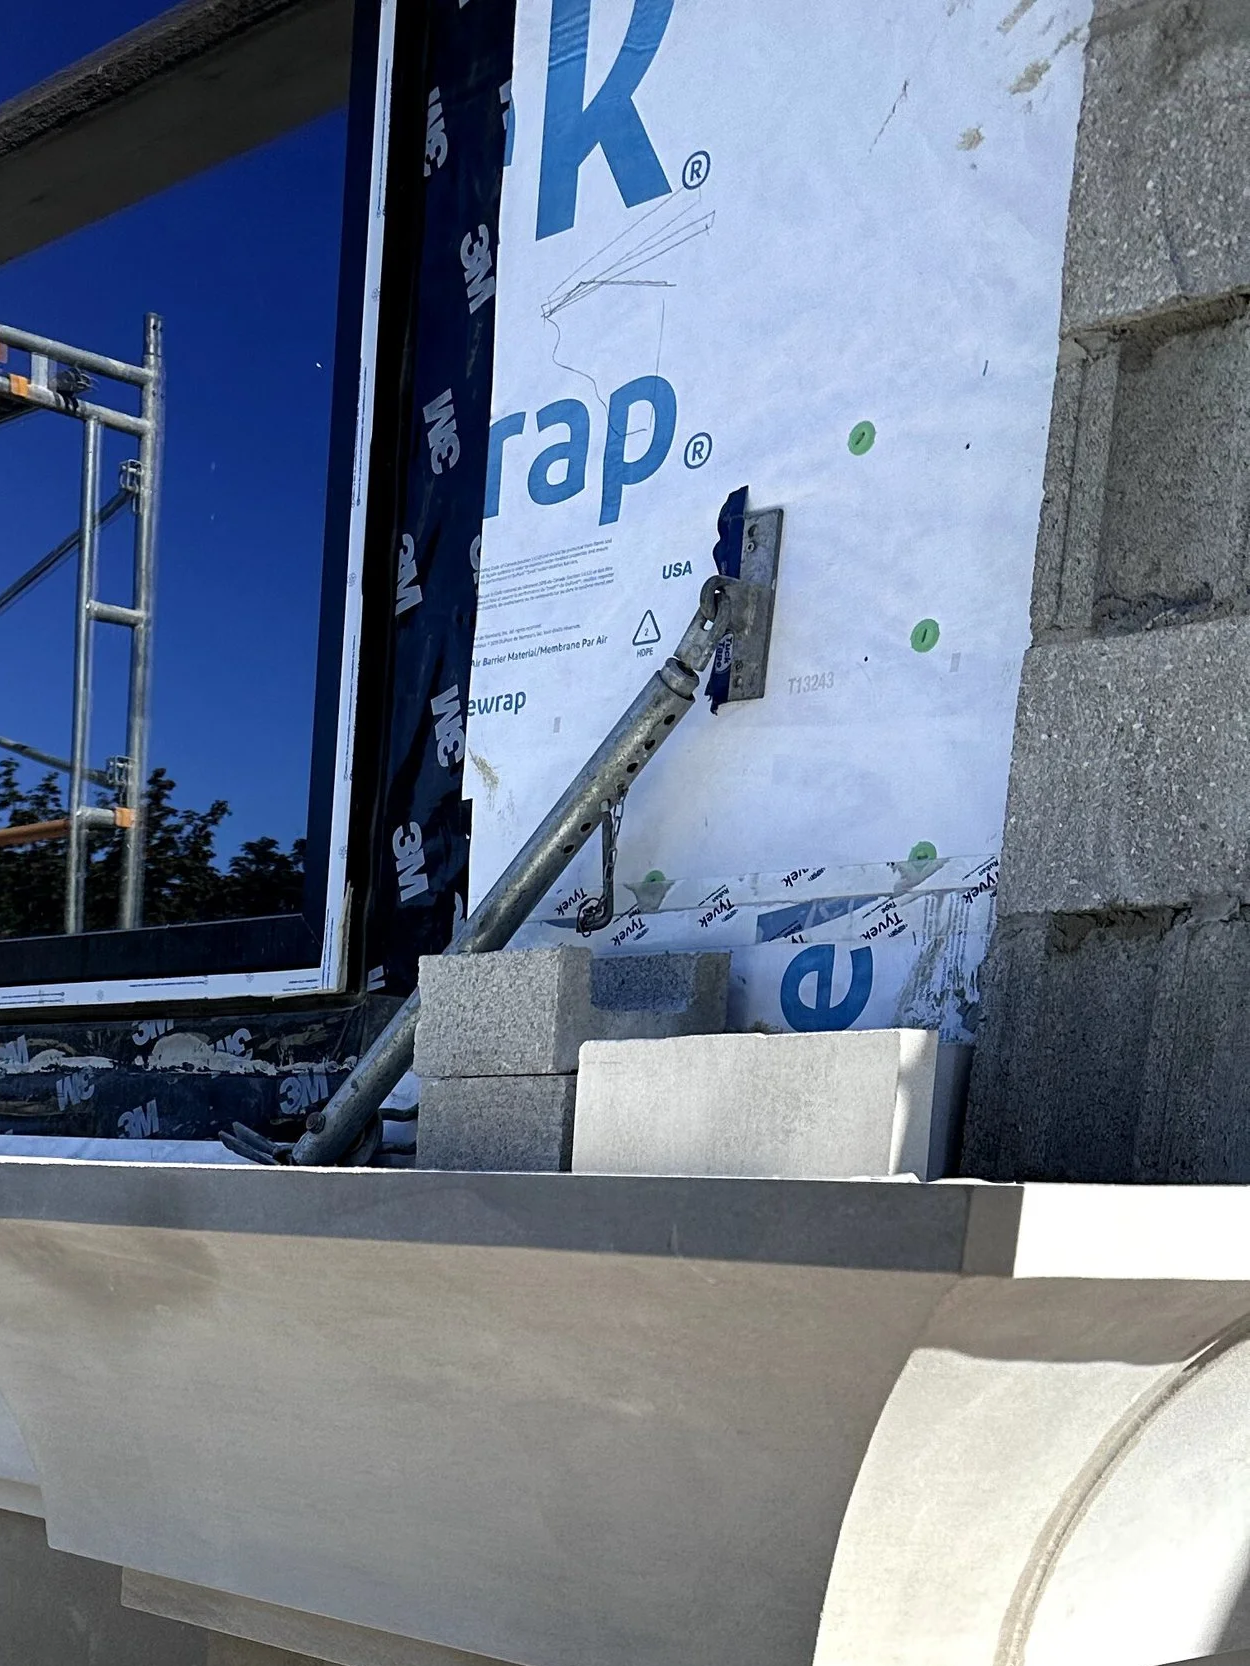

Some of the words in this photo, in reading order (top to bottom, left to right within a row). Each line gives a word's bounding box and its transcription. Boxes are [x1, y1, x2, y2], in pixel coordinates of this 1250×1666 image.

[459, 223, 497, 316] 3M
[422, 387, 461, 475] 3M
[662, 560, 693, 580] USA
[482, 654, 507, 667] Barrier
[581, 637, 596, 649] Par
[596, 634, 608, 646] Air
[788, 671, 835, 695] T13243
[467, 690, 527, 717] ewrap
[430, 684, 466, 768] 3M
[392, 821, 429, 902] 3M
[554, 887, 588, 916] Tyvek
[698, 898, 735, 928] Tyvek
[610, 918, 646, 946] Tyvek
[860, 912, 903, 940] Tyvek
[55, 1066, 96, 1112] 3M
[279, 1059, 330, 1115] 3M
[116, 1098, 161, 1140] 3M
